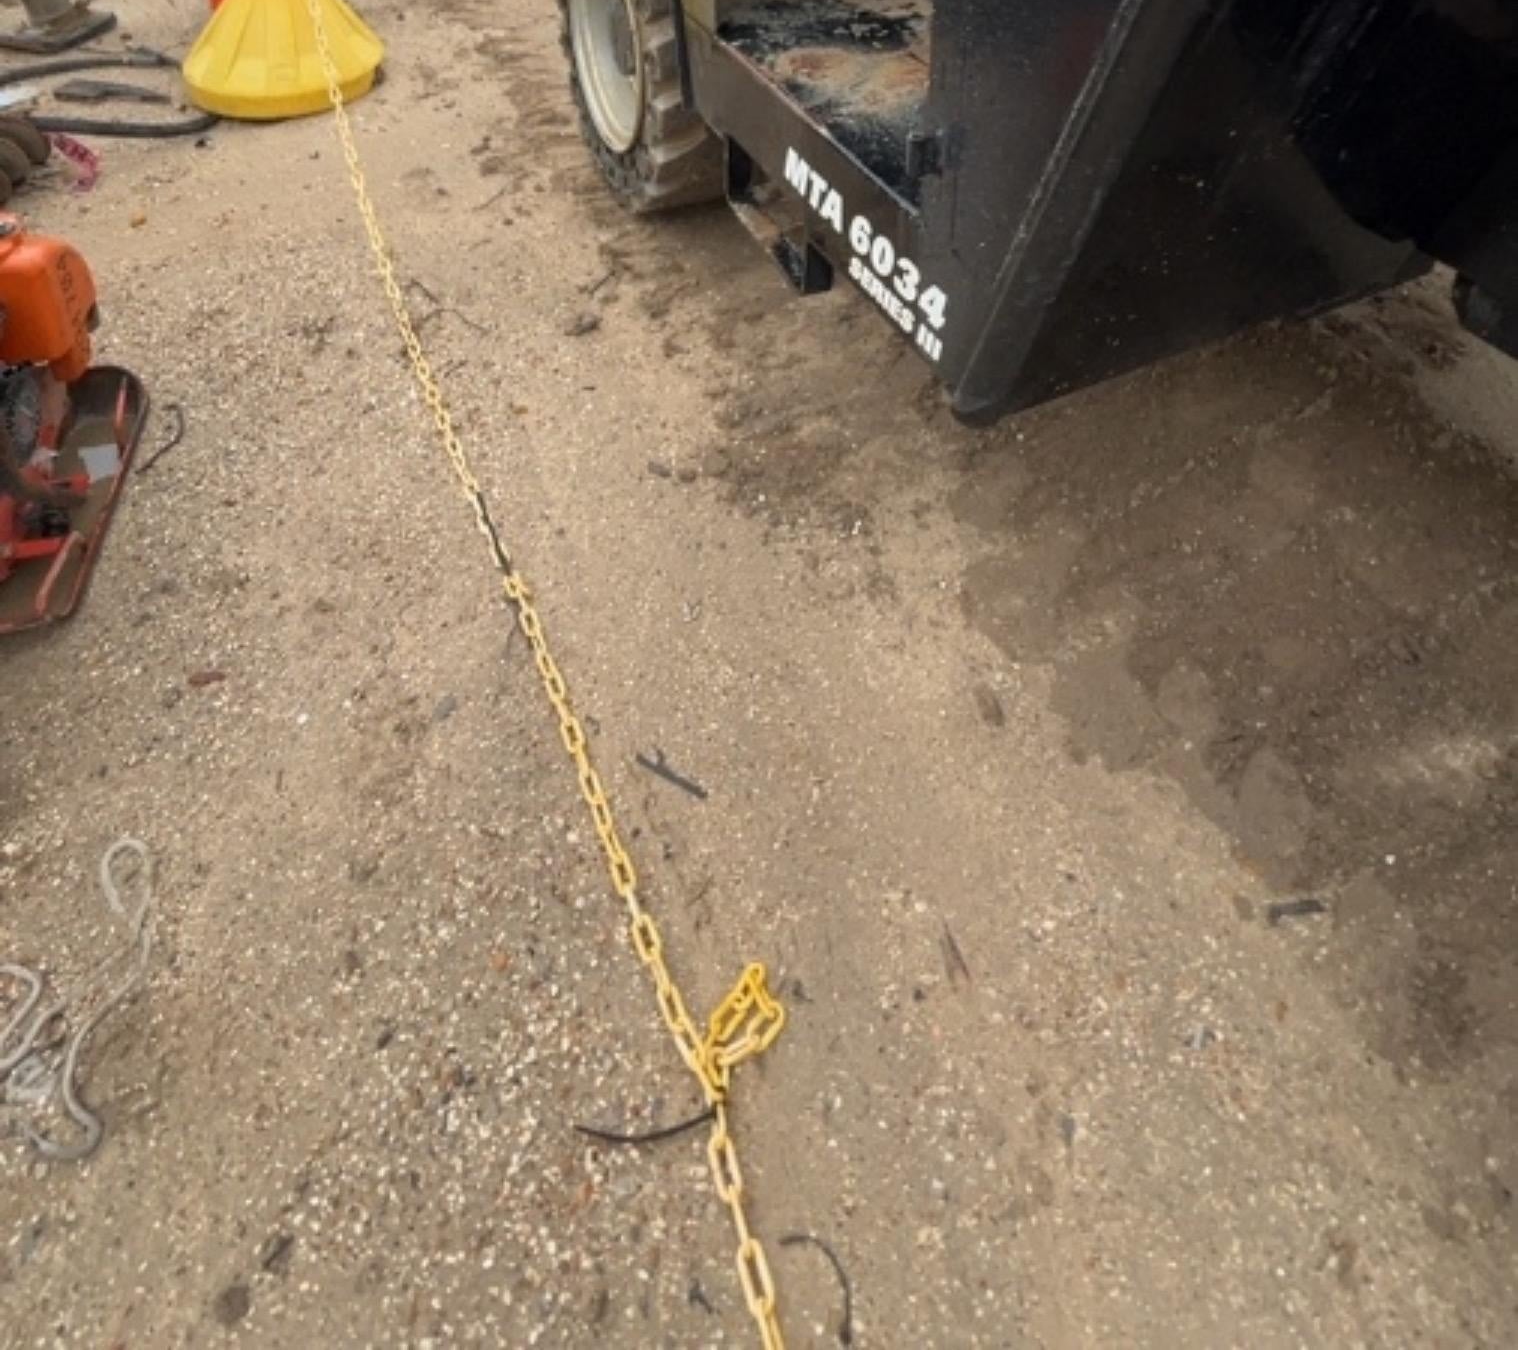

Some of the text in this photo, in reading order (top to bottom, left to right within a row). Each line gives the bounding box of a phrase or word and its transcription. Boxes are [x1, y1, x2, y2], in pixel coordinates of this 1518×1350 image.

[784, 146, 948, 331] MTA 6034
[848, 256, 943, 362] SERIES III
